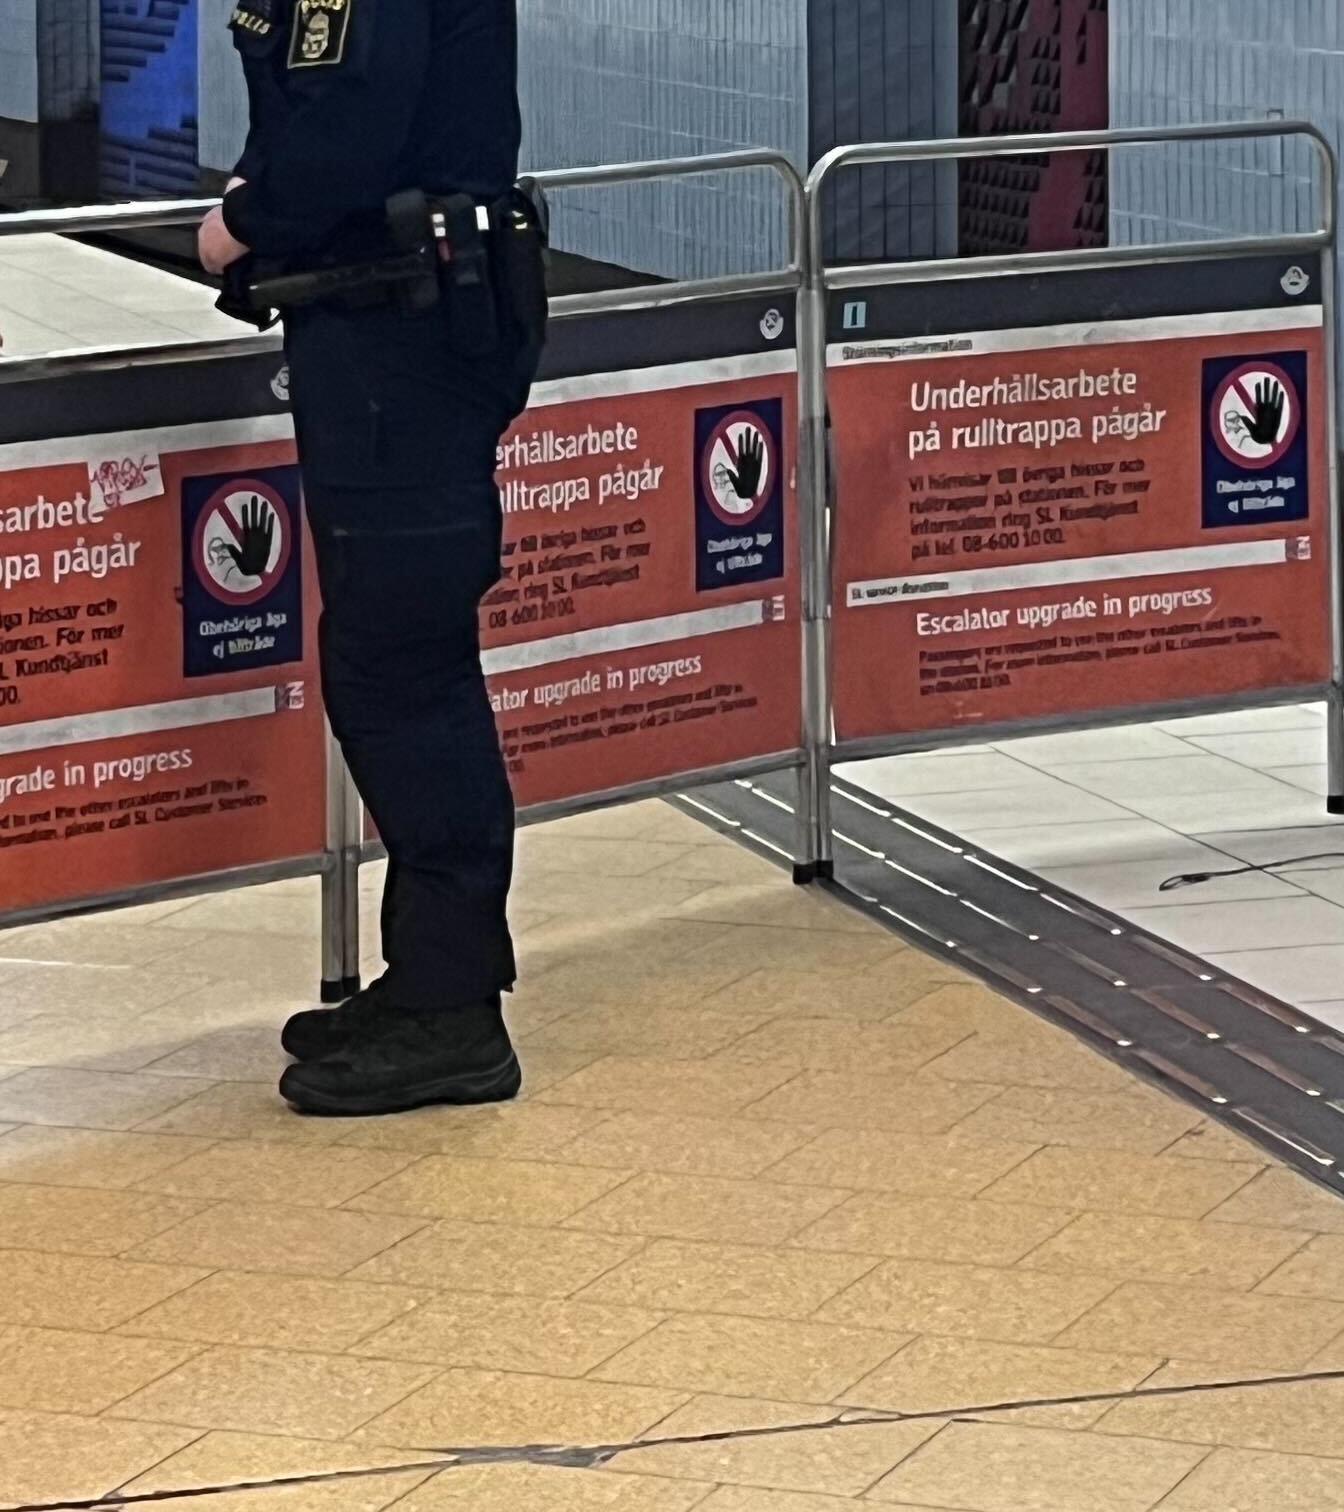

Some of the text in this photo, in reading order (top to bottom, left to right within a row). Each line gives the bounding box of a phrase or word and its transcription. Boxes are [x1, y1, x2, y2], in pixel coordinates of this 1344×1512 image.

[910, 367, 1137, 413] Underhållsarbete
[908, 402, 1167, 460] på rulltrappa pågår
[599, 458, 664, 505] pågår
[54, 536, 142, 584] pågår
[916, 587, 1212, 636] Escalator upgrade in progress
[533, 670, 601, 708] upgrade
[606, 666, 623, 689] in
[628, 654, 702, 691] progress
[63, 760, 85, 786] in
[93, 748, 193, 788] progress
